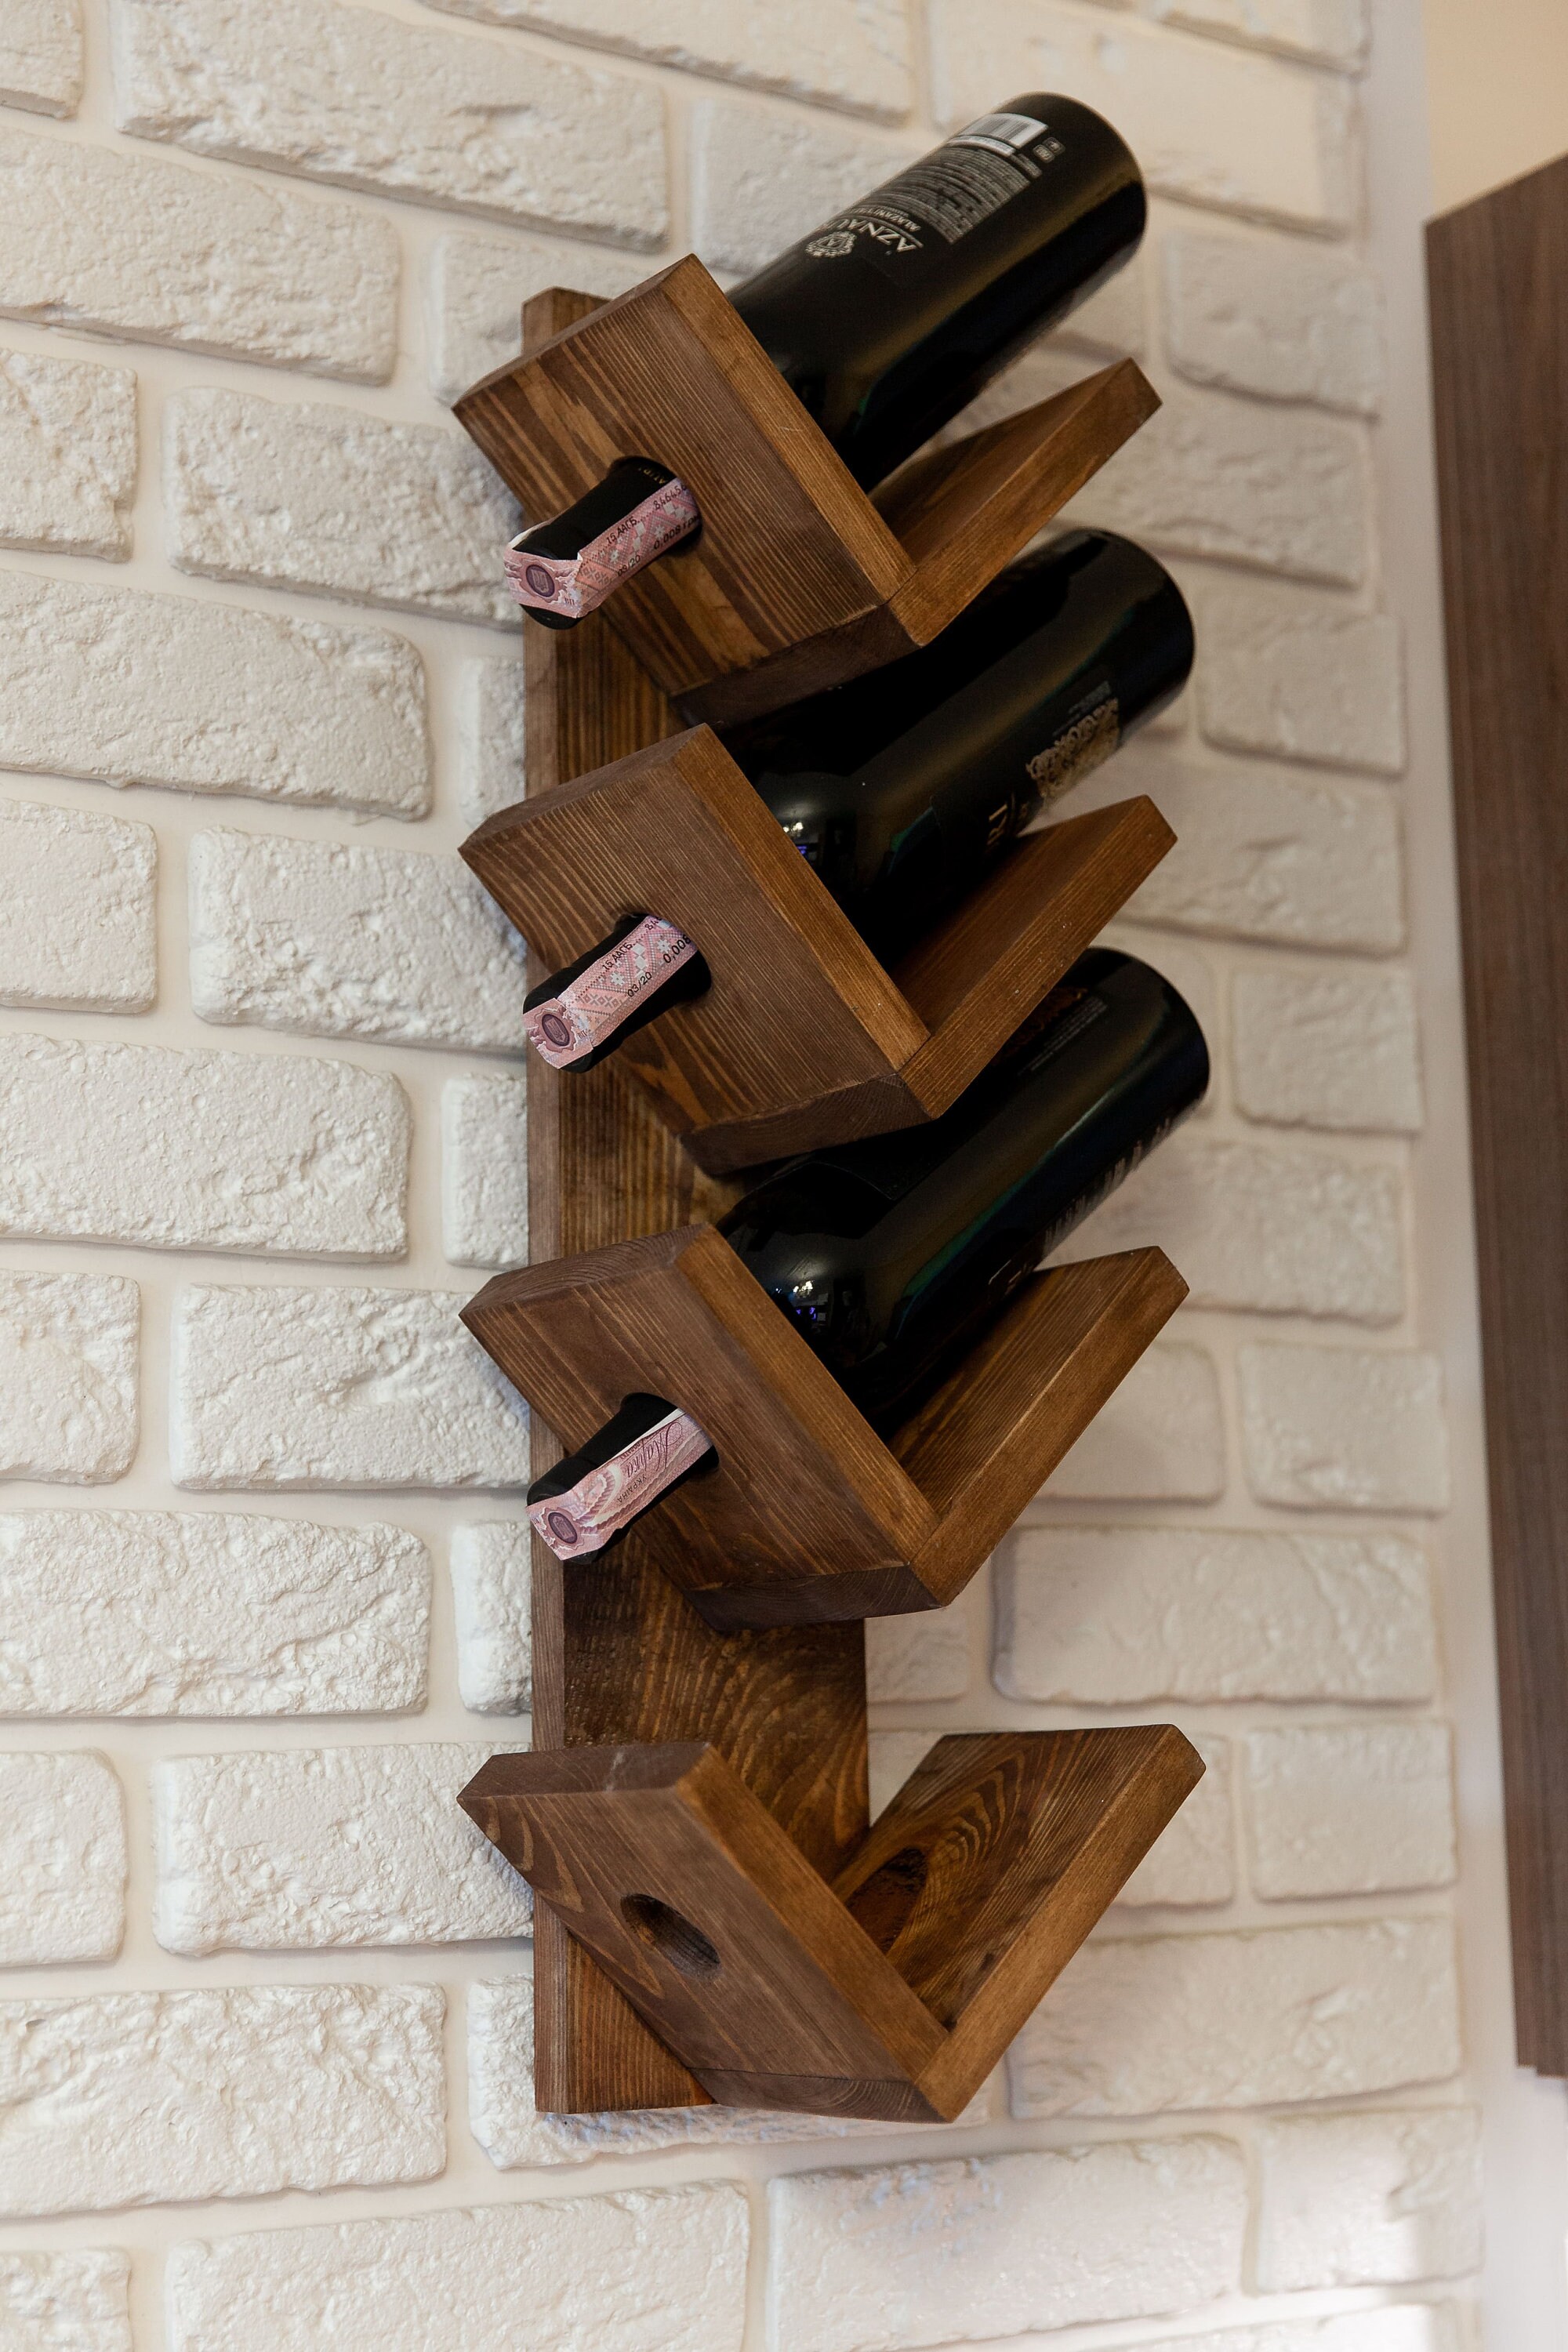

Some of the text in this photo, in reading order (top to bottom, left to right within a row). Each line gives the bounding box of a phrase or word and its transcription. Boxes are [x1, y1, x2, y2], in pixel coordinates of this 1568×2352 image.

[663, 935, 691, 964] 0,008
[603, 960, 613, 971] 15
[627, 971, 652, 996] 03/20
